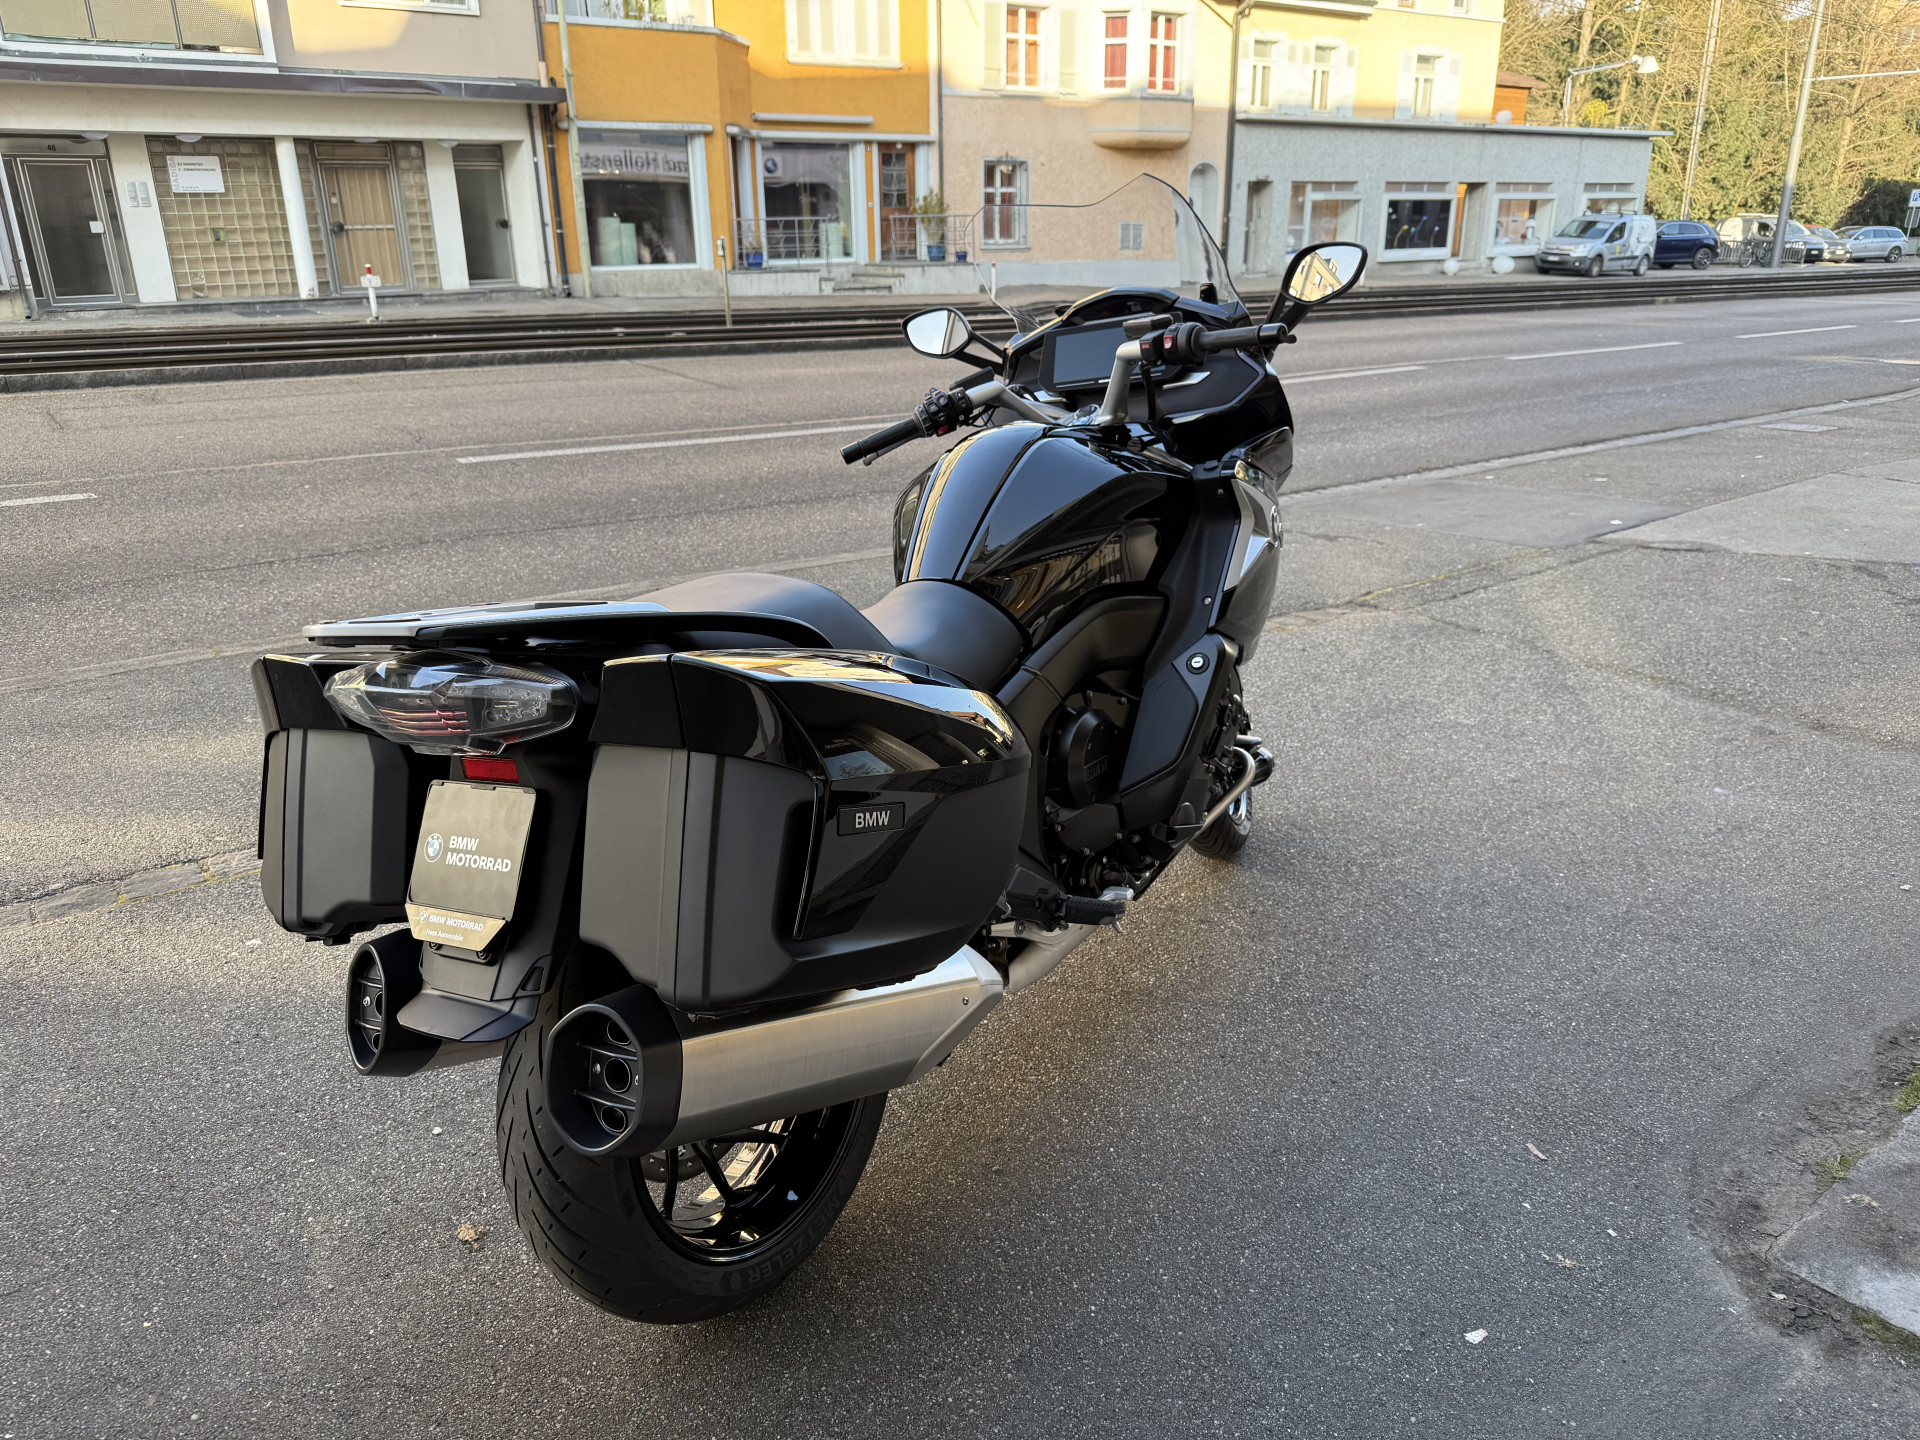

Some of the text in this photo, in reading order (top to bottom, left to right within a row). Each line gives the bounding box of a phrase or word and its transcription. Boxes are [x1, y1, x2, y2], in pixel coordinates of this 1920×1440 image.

[855, 810, 891, 828] BMW
[449, 835, 480, 851] BMW
[445, 851, 512, 872] MOTORRAD
[429, 914, 447, 925] BMW
[446, 917, 484, 932] MOTORRAD
[437, 930, 464, 941] Automobile
[747, 1196, 841, 1284] METZELER
